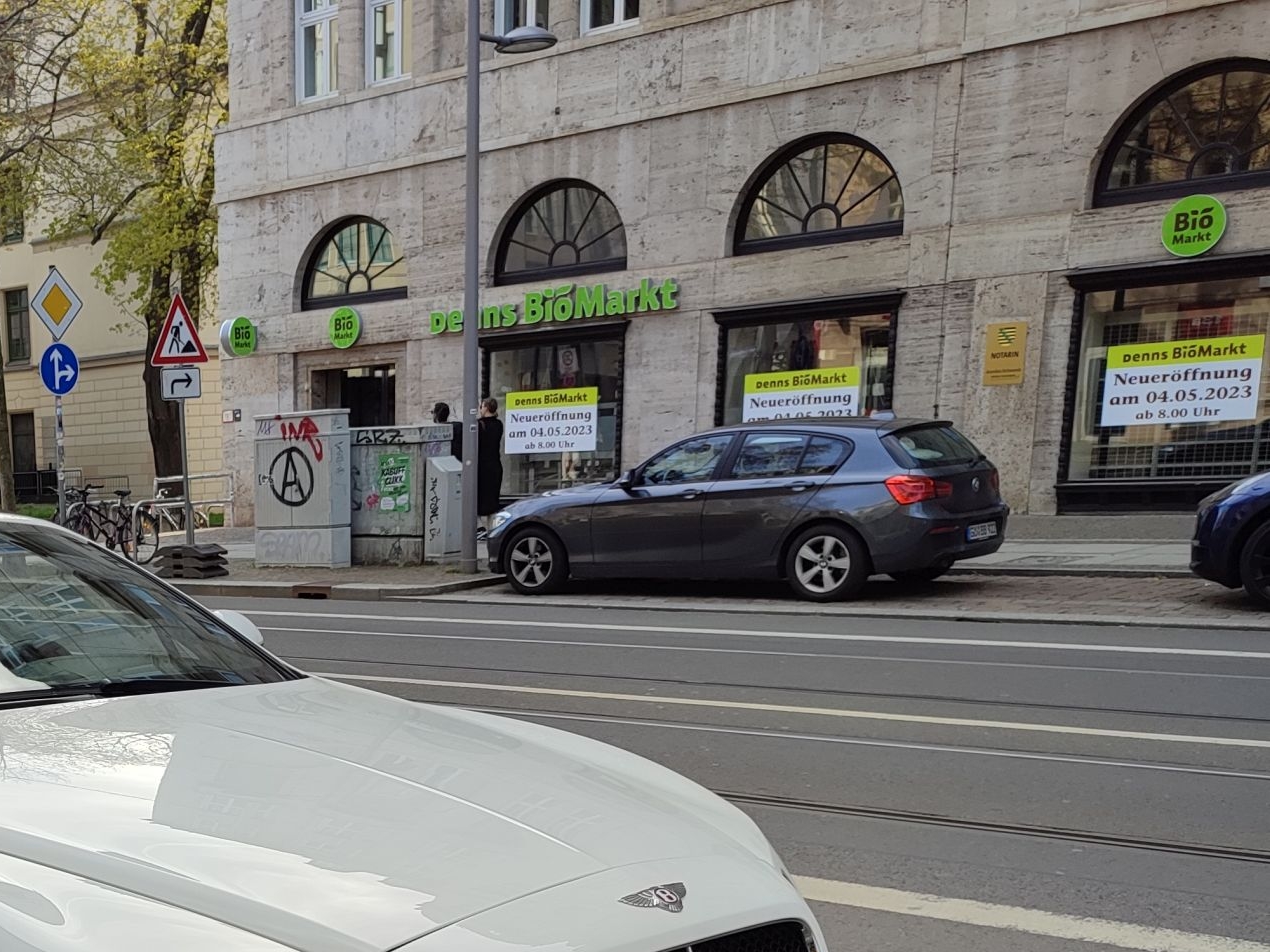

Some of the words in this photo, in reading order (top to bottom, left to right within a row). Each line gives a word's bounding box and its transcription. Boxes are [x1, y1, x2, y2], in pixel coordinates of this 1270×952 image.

[1171, 231, 1212, 245] Markt
[334, 332, 353, 340] Markt
[991, 351, 1019, 359] NOTARIN
[1114, 367, 1252, 386] Neueröffnung
[750, 393, 852, 409] Neueröffnung
[1110, 394, 1139, 406] am
[1146, 385, 1252, 403] 04.05.2023
[510, 411, 592, 423] Neueröffnung
[1135, 409, 1153, 420] ab
[1158, 408, 1188, 419] 8.00
[1193, 406, 1221, 417] Uhr
[509, 430, 527, 439] am
[530, 424, 593, 438] 04.05.2023
[524, 441, 536, 450] ab
[537, 441, 556, 449] 8.00
[558, 440, 575, 449] Uhr
